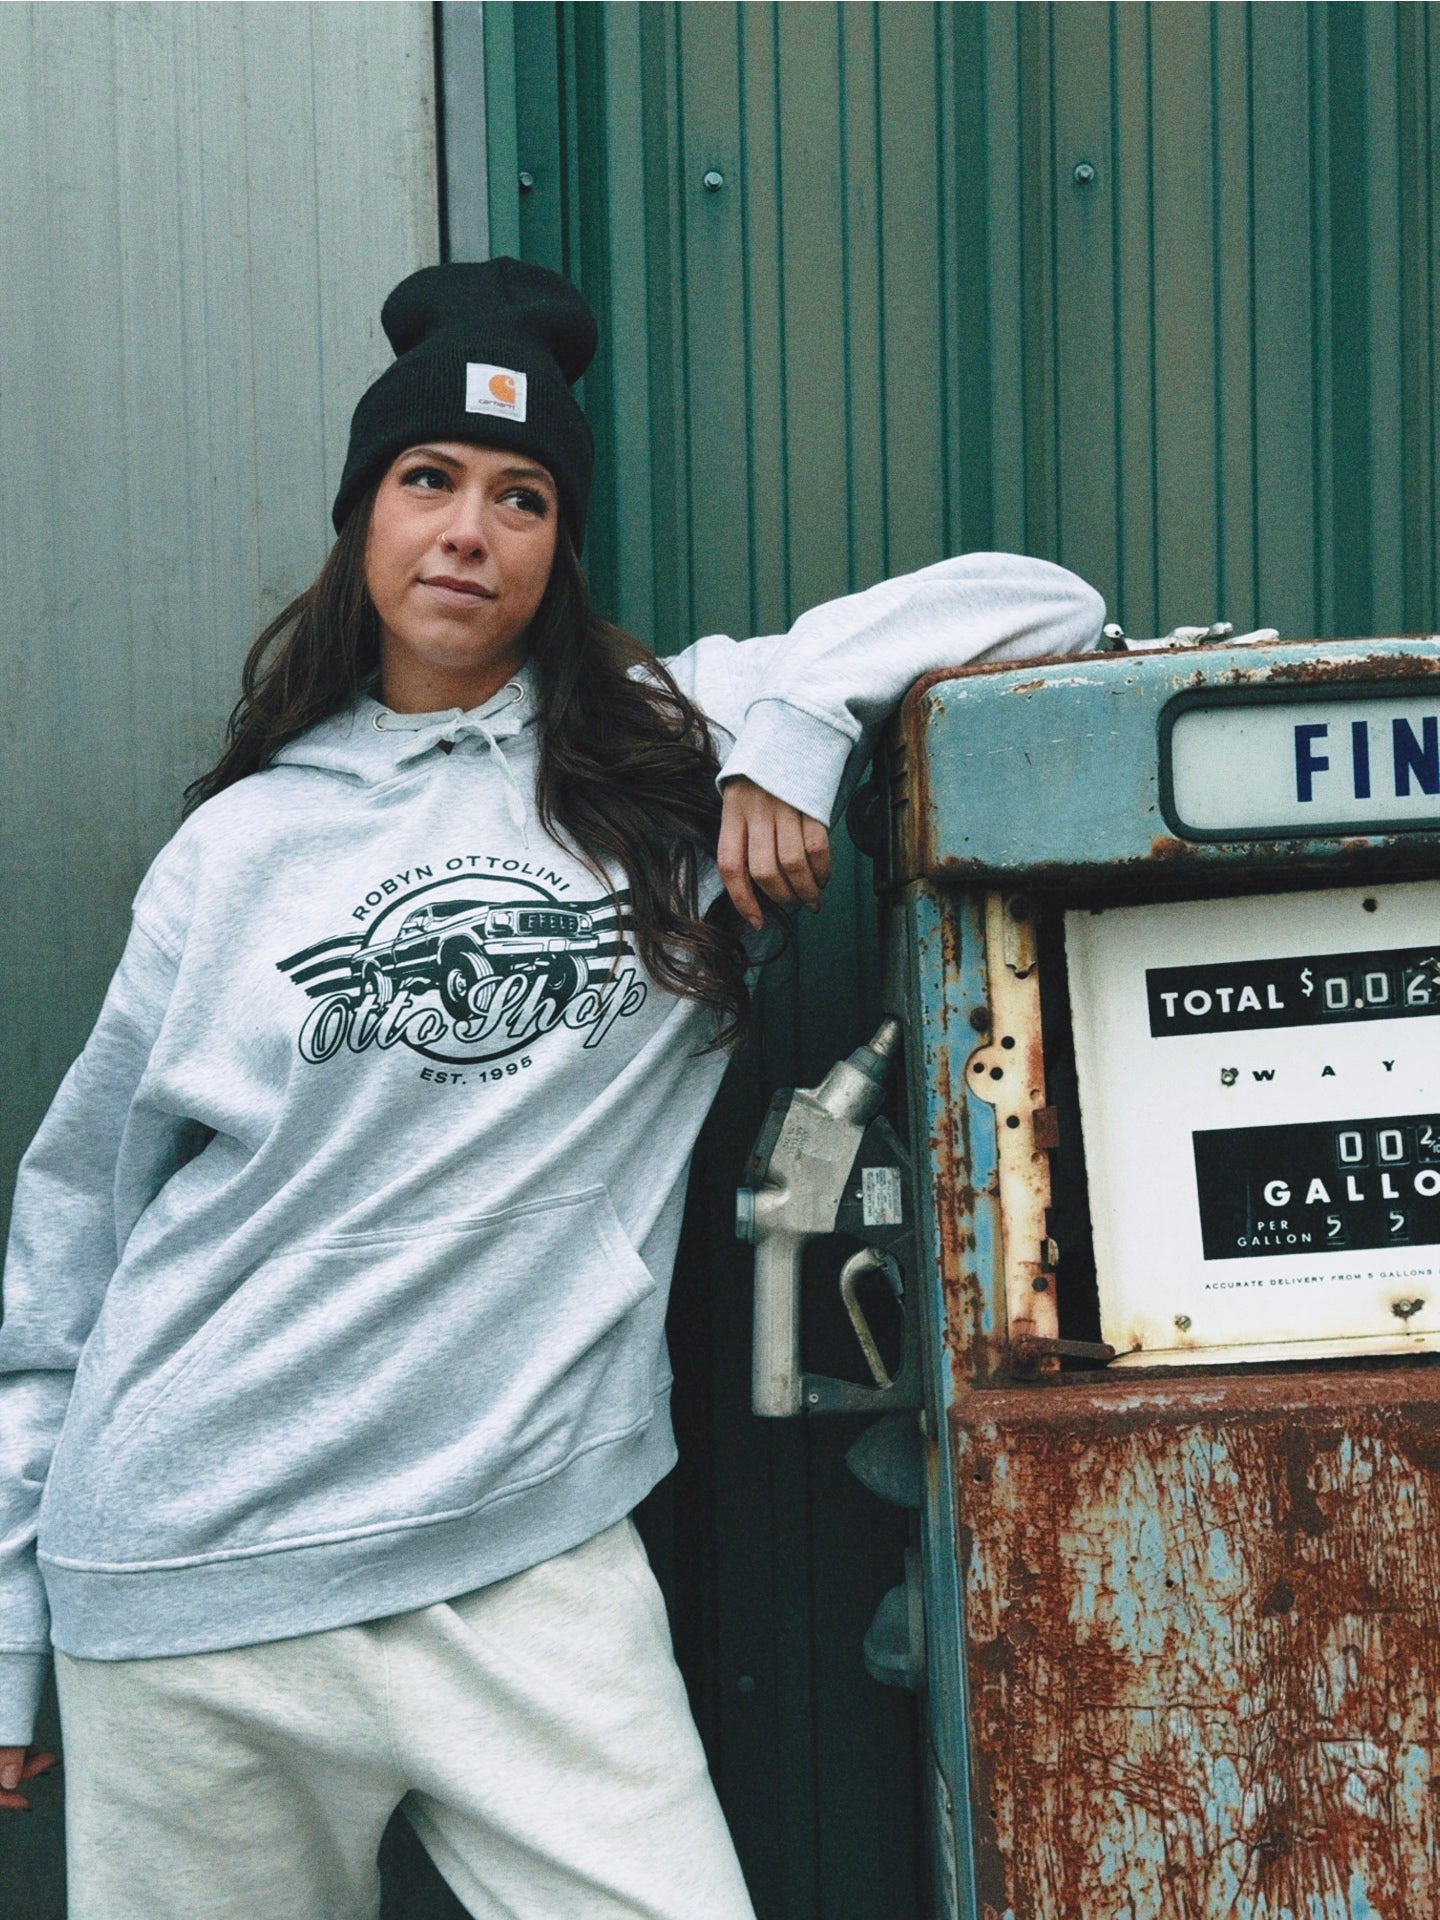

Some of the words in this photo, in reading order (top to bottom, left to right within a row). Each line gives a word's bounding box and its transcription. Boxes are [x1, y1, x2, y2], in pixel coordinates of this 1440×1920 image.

[1294, 716, 1440, 803] FIN
[352, 864, 434, 921] ROBYN
[445, 855, 571, 892] OTTOLINI
[299, 992, 449, 1064] Otto
[453, 968, 647, 1048] Shop
[1161, 984, 1285, 1018] TOTAL
[419, 1066, 468, 1085] EST.
[478, 1055, 533, 1084] 1995
[1236, 1232, 1312, 1247] GALLON
[1257, 1219, 1289, 1231] PER
[1204, 1279, 1264, 1290] ACCURATE
[1270, 1274, 1325, 1286] DELIVERY
[1331, 1273, 1362, 1281] FROM
[1380, 1268, 1433, 1278] GALLONS
